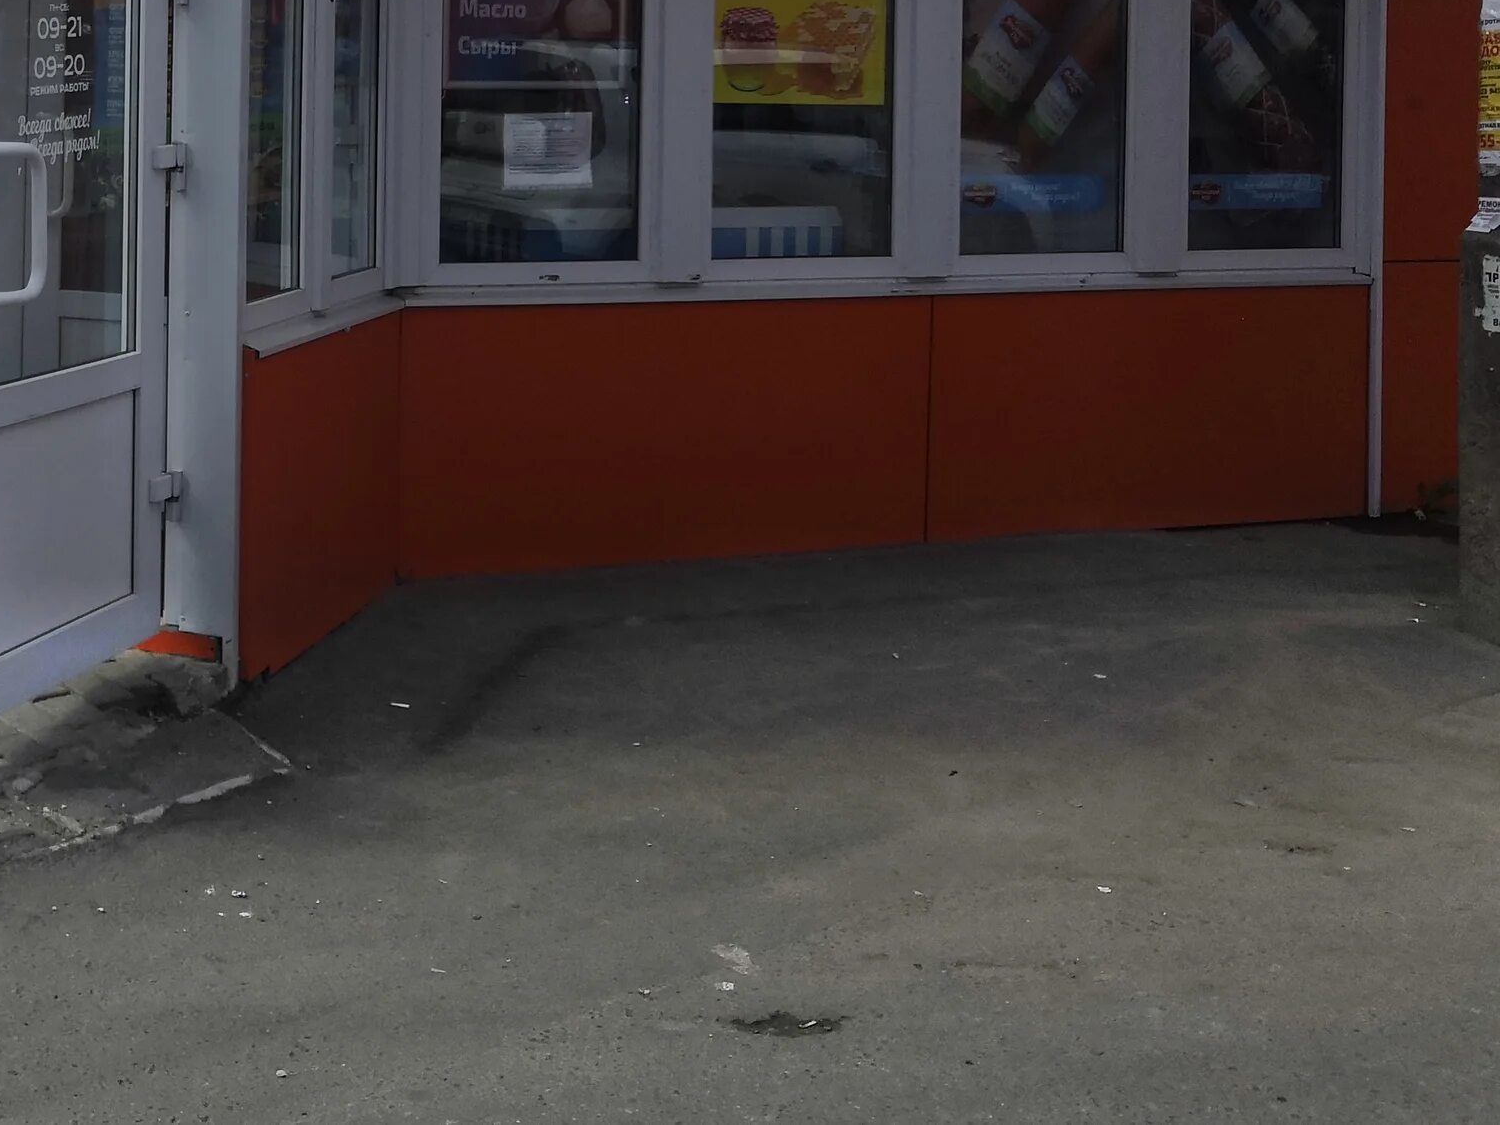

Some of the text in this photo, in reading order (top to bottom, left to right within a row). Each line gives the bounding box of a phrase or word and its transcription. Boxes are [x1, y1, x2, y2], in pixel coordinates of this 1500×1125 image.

[37, 16, 82, 39] 09-21
[458, 36, 517, 59] Сыры
[33, 54, 86, 79] 09-20
[29, 81, 91, 97] РЕЖИМ РАБОТЫ
[17, 108, 92, 142] Всегда свежее!
[64, 129, 102, 163] рядом!
